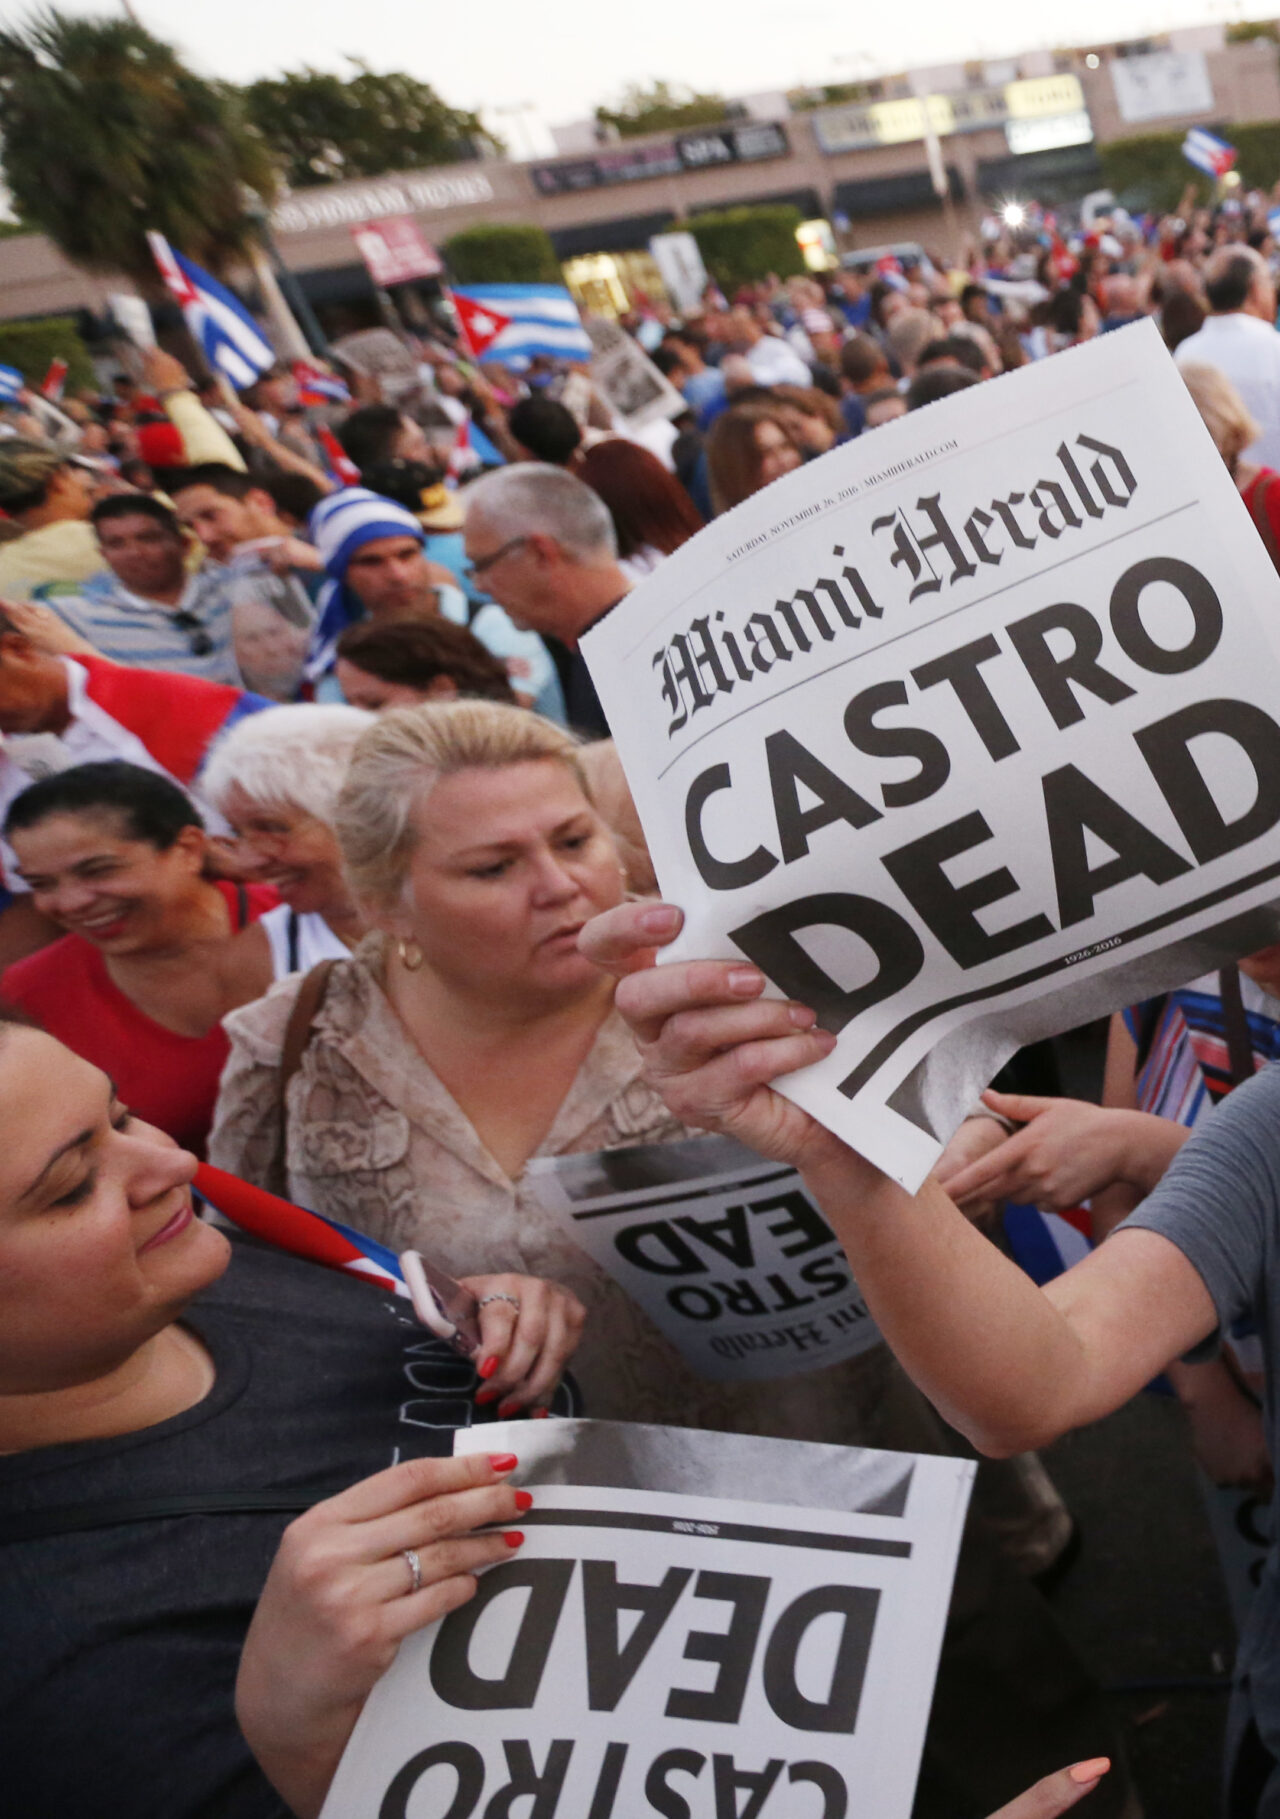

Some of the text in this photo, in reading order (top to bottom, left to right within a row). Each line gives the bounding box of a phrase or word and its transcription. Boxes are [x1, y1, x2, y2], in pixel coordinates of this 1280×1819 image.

[769, 503, 822, 536] NOVEMBER
[651, 434, 1138, 738] Miami Herald
[685, 556, 1224, 891] CASTRO
[1064, 936, 1122, 965] 1926-2016
[613, 1189, 838, 1276] EAD
[666, 1249, 848, 1321] STRO
[428, 1558, 882, 1735] DEAD
